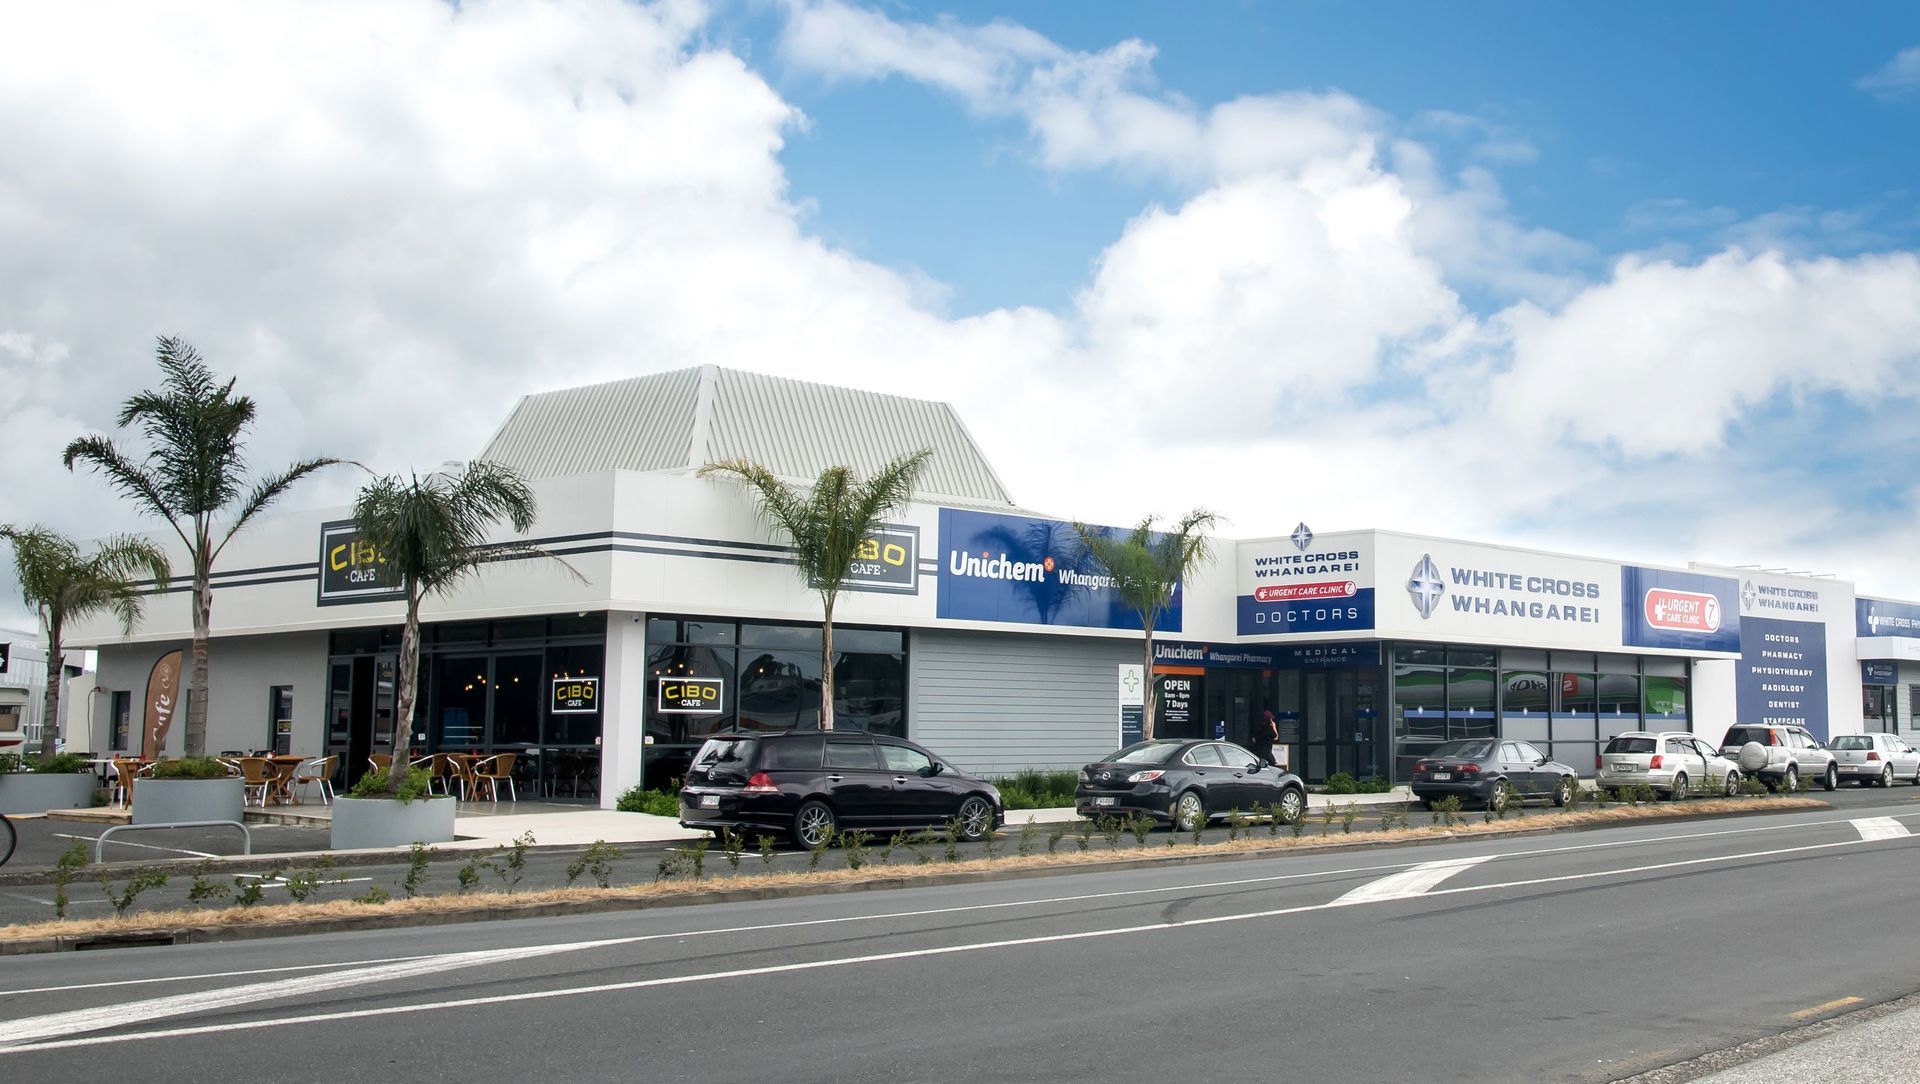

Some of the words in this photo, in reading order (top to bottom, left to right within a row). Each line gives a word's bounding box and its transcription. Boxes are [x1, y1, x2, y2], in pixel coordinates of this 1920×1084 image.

[330, 542, 386, 572] CIB
[1255, 555, 1302, 566] WHITE
[1304, 551, 1359, 563] CROSS
[850, 562, 881, 576] CAFE
[950, 550, 1045, 582] Unichem
[1255, 563, 1359, 577] WHANGAREI
[350, 568, 376, 583] CAFE
[1450, 567, 1523, 591] WHITE
[1527, 576, 1600, 599] CROSS
[1268, 588, 1297, 597] URGENT
[1298, 587, 1318, 596] CARE
[1319, 585, 1343, 594] CLINIC
[1758, 585, 1787, 597] WHITE
[1787, 588, 1819, 600] CROSS
[1451, 594, 1600, 624] WHANGAREI
[1667, 598, 1700, 614] URGENT
[1758, 598, 1819, 612] WHANGAREI
[1255, 608, 1358, 624] DOCTORS
[1666, 613, 1682, 623] CARE
[1682, 614, 1701, 624] CLINIC
[1764, 633, 1800, 643] DOCTORS
[1156, 644, 1204, 660] Unichem
[1209, 651, 1243, 664] Whangarei
[1243, 653, 1272, 665] Pharmacy
[1294, 647, 1358, 657] MEDICAL
[1762, 650, 1803, 660] PHARMACY
[1304, 656, 1347, 664] ENTRANCE
[1751, 666, 1813, 677] PHYSIOTHERAPY
[557, 685, 594, 700] CIBO
[665, 685, 717, 700] CIBO
[1164, 680, 1190, 691] OPEN
[1762, 684, 1805, 693] RADIOLOGY
[681, 699, 701, 707] CAFE
[1166, 700, 1171, 708] 7
[1172, 700, 1189, 709] Days
[1768, 701, 1800, 709] DENTIST
